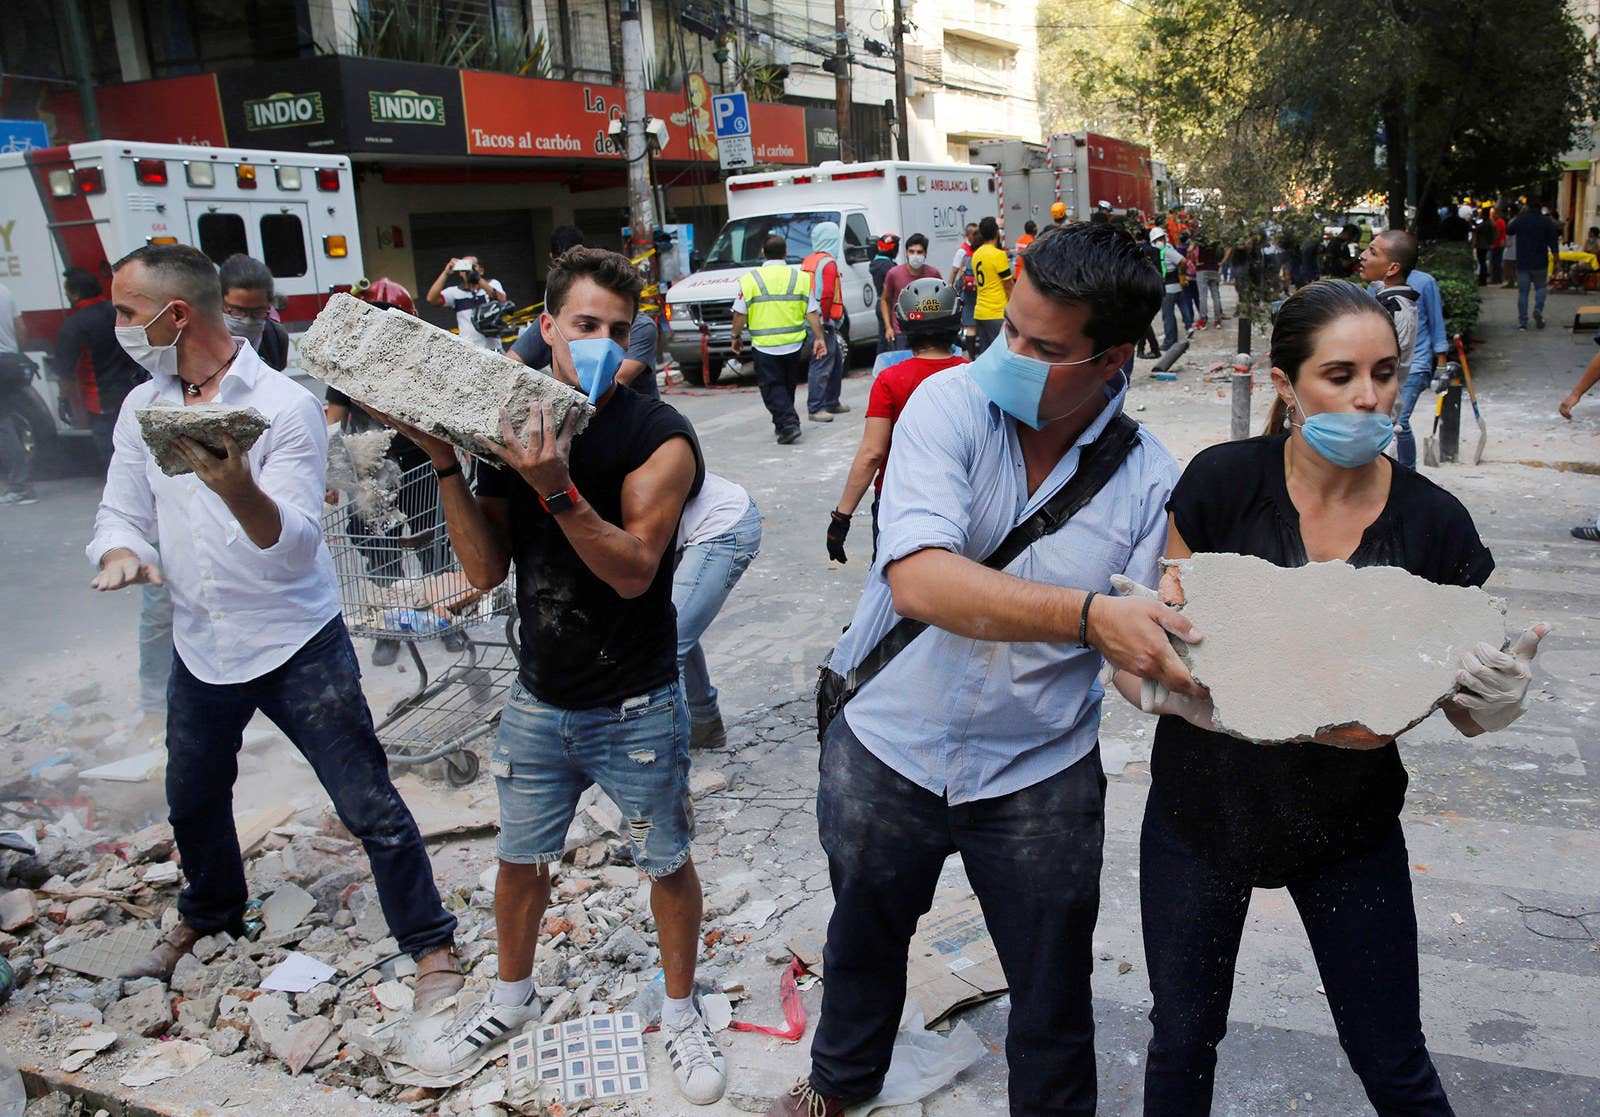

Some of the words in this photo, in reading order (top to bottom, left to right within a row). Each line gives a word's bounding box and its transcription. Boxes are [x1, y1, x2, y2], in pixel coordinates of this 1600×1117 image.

[254, 99, 313, 125] INDIO
[378, 96, 436, 120] INDIO
[584, 88, 605, 112] La
[715, 98, 734, 128] P
[472, 128, 514, 149] Tacos
[518, 131, 532, 149] al
[535, 134, 581, 151] carbón
[757, 144, 765, 157] al
[767, 145, 794, 157] carbón
[930, 179, 969, 191] AMBULANCIA
[975, 261, 985, 287] 6
